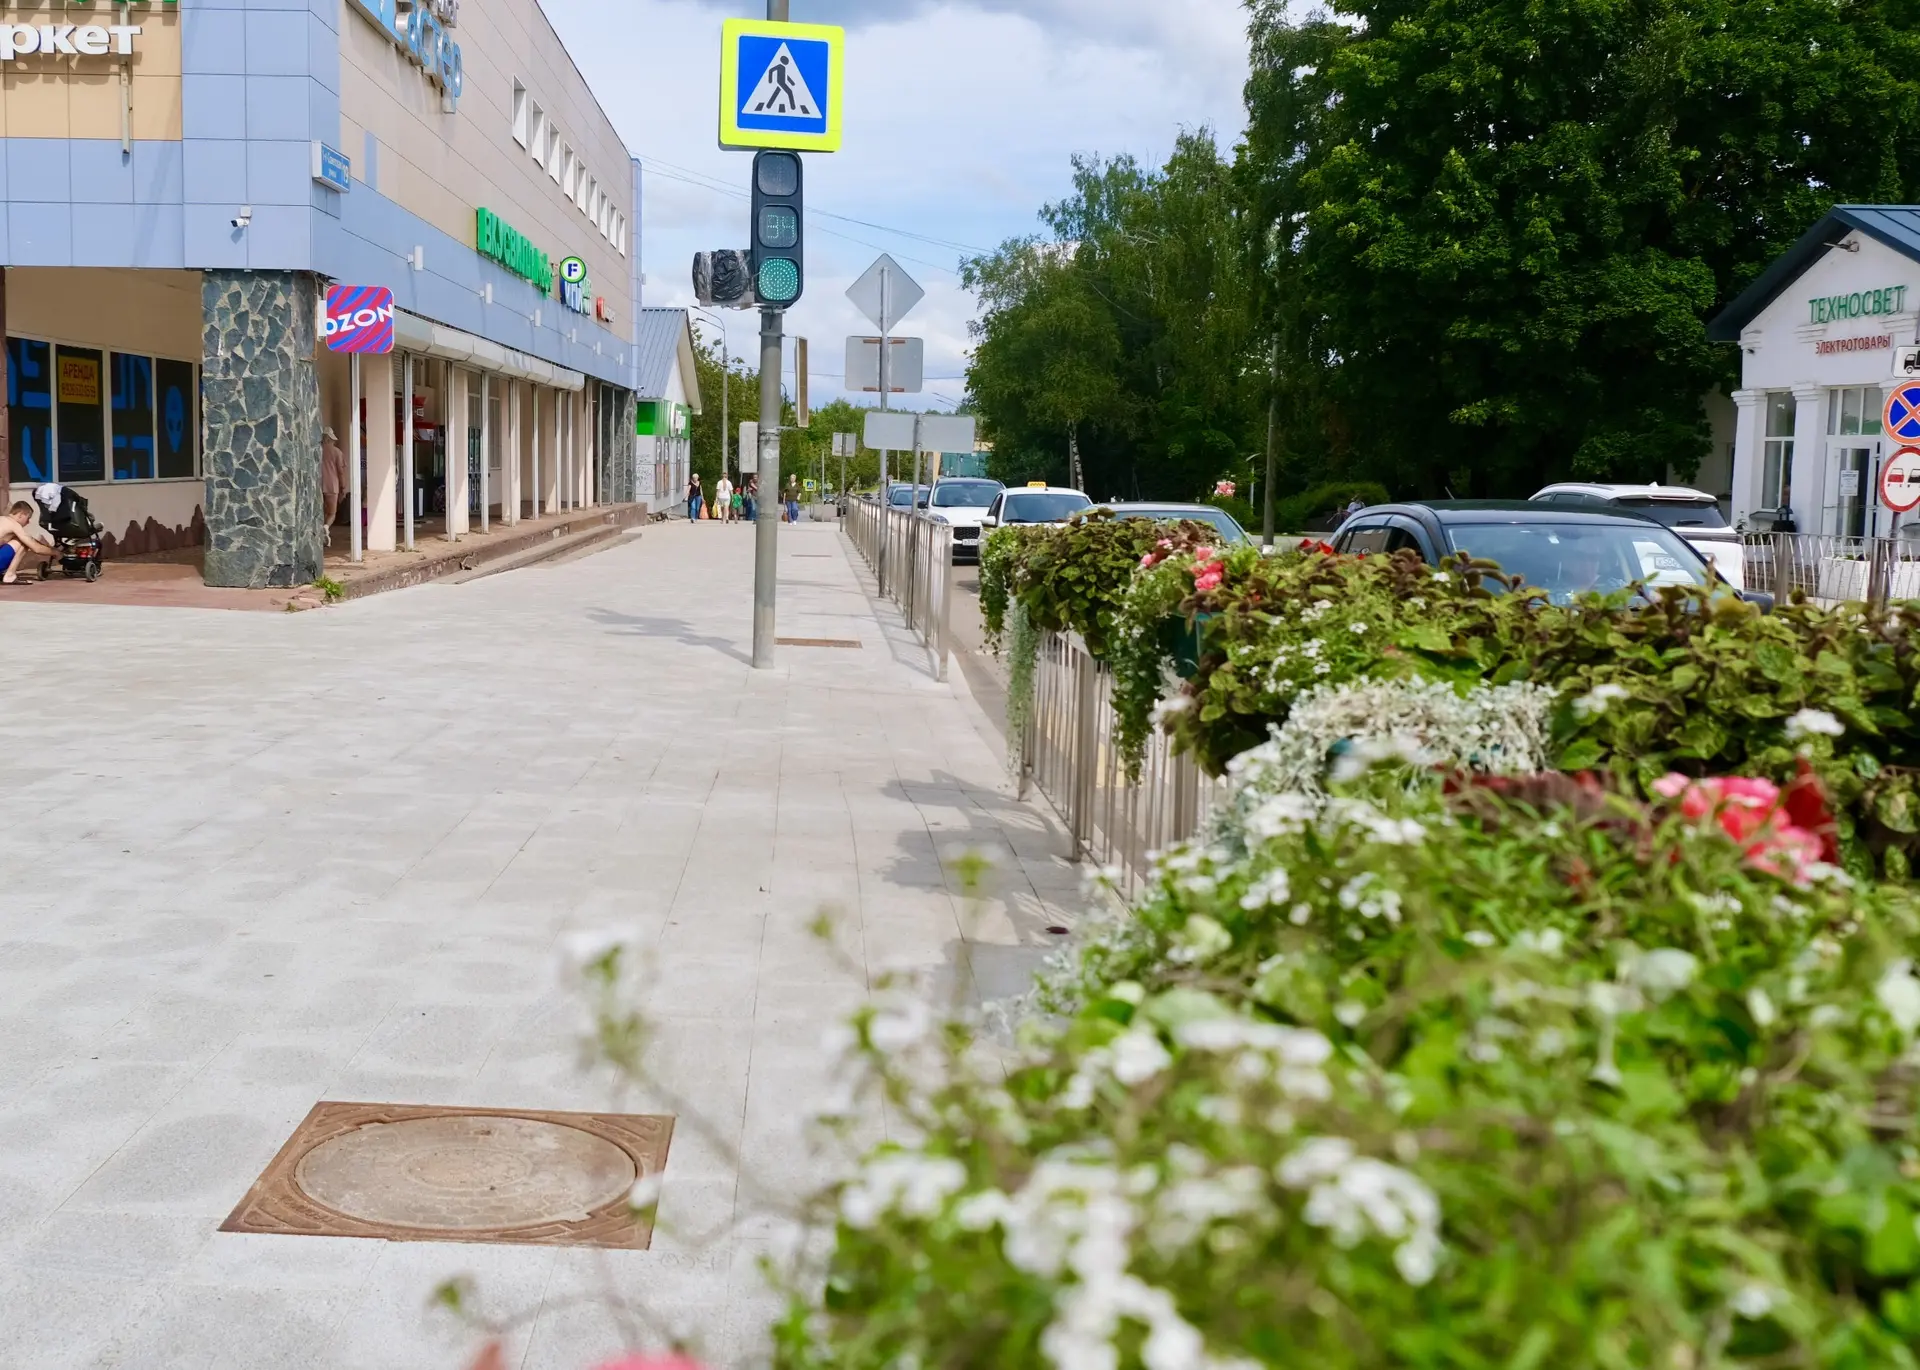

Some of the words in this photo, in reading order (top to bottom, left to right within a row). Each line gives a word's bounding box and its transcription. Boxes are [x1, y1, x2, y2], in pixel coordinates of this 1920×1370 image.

[0, 23, 142, 60] ркет
[767, 214, 795, 239] 34
[1808, 284, 1905, 324] ТЕХНОСВЕТ
[1815, 334, 1892, 355] ЭЛЕКТРОТОВАРЫ
[63, 362, 95, 382] АРЕНДА
